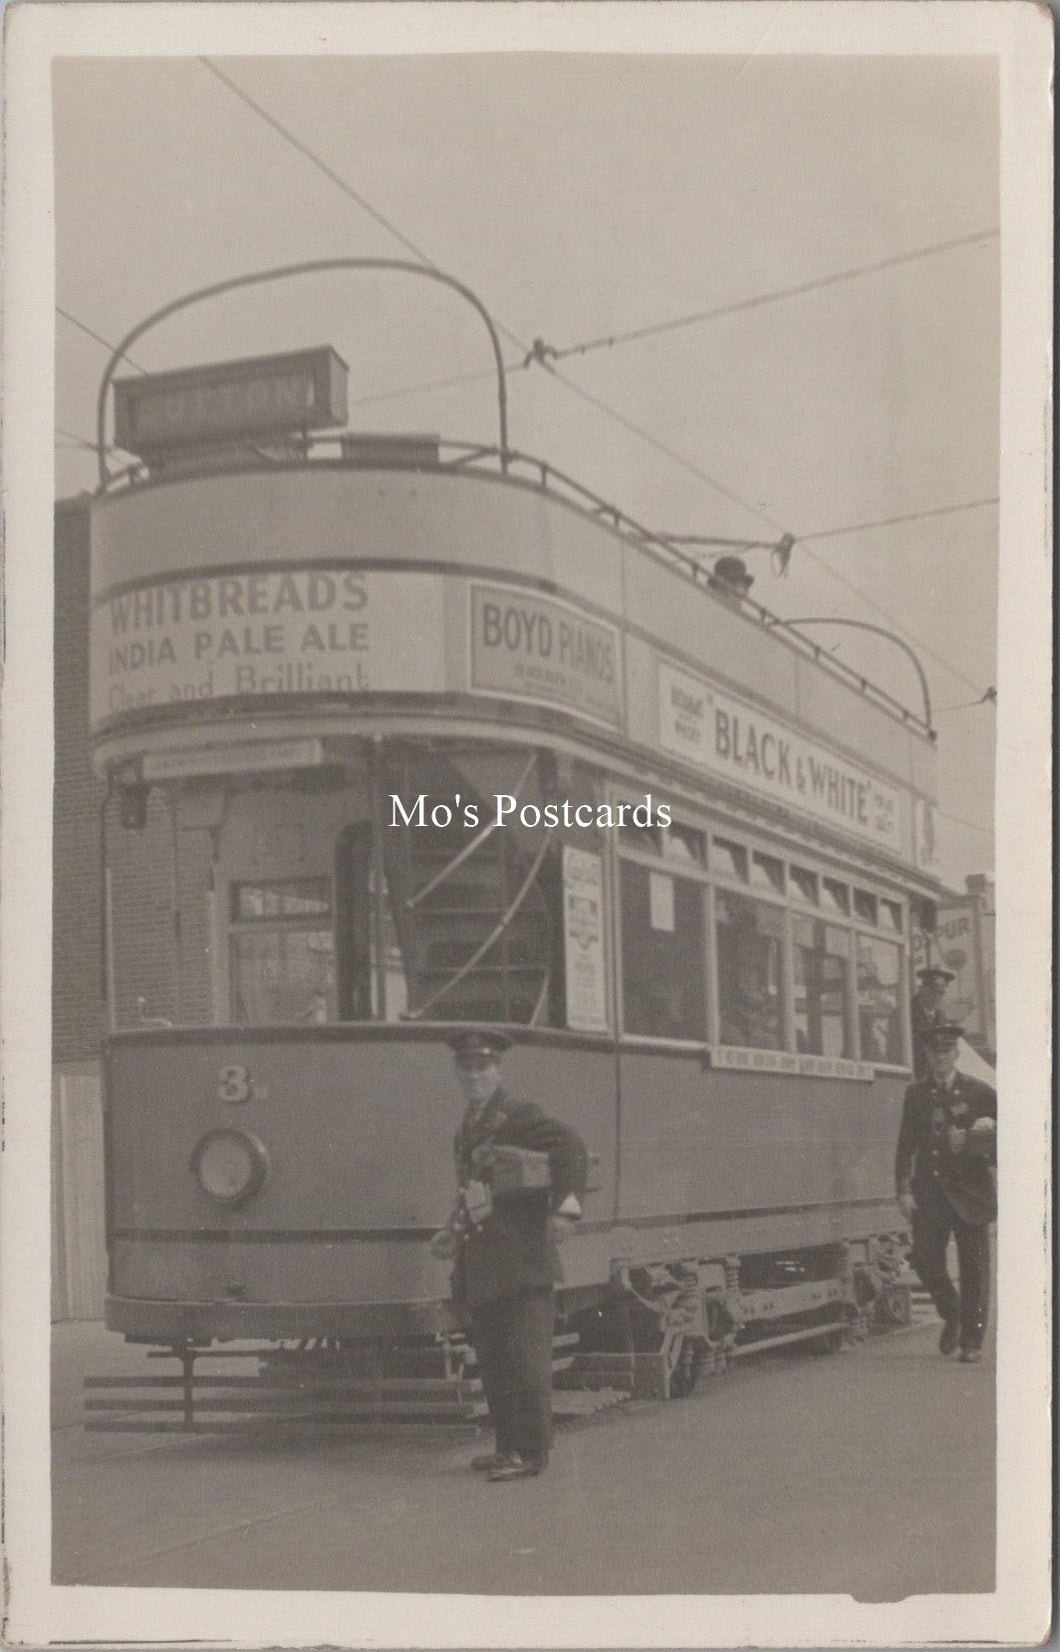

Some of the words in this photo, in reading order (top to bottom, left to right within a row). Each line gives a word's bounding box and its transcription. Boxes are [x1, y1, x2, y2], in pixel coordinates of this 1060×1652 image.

[110, 573, 369, 636] WHITBREADS
[482, 602, 552, 659] BOYD
[109, 636, 178, 676] INDIA
[194, 625, 285, 660] PALE
[301, 622, 370, 653] ALE
[170, 669, 214, 700] and
[235, 662, 370, 694] Brilliant
